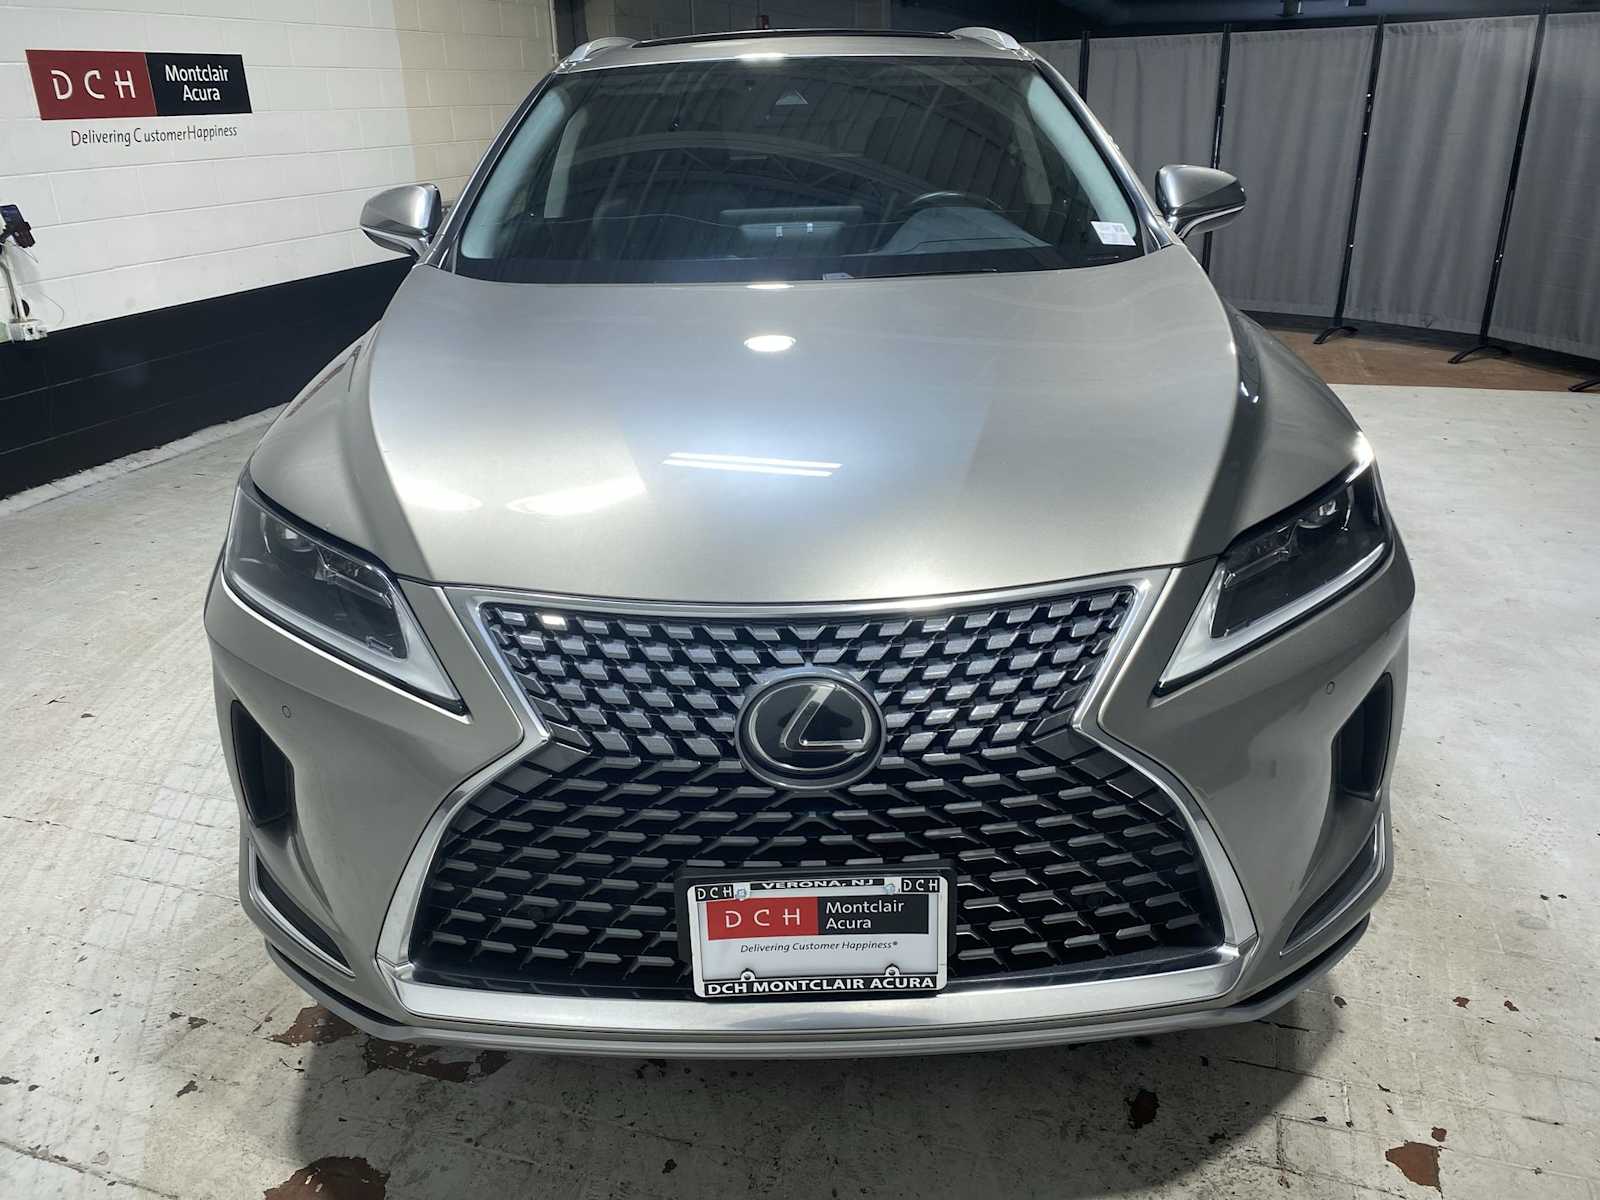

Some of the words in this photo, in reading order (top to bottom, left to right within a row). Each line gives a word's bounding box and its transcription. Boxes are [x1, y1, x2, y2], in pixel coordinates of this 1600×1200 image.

[165, 64, 229, 82] Montclair
[183, 85, 221, 101] Acura
[71, 130, 131, 147] Delivering
[826, 900, 905, 914] Montclair
[826, 917, 872, 930] Acura
[740, 943, 790, 953] Delivering
[792, 941, 840, 951] Customer
[707, 982, 748, 995] DCH
[752, 977, 865, 993] MONTCLAIR
[870, 976, 935, 990] ACURA
